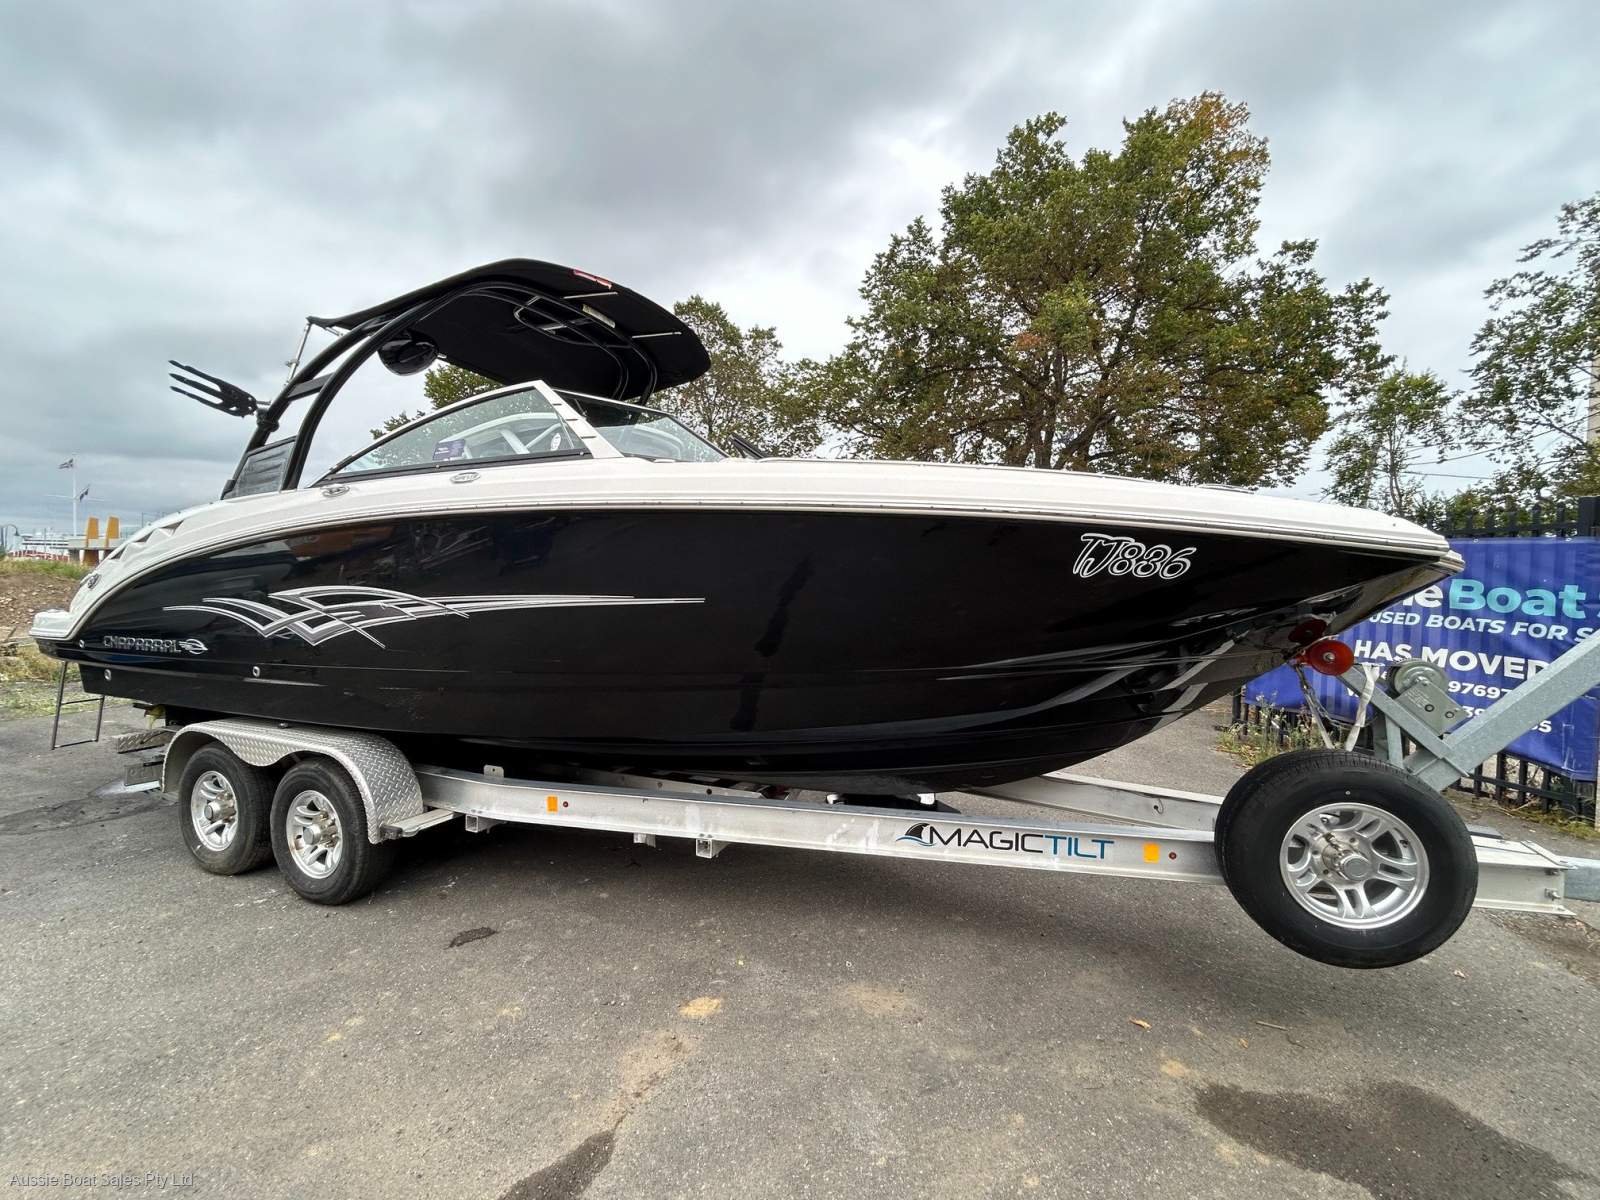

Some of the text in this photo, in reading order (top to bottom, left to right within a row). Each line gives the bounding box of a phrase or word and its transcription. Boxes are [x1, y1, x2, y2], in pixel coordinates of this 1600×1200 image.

[1073, 533, 1197, 580] TJ836
[1425, 614, 1506, 634] BOATS
[1511, 621, 1568, 640] FOR
[1354, 640, 1412, 662] HAS
[929, 825, 1114, 860] MAGICTILT
